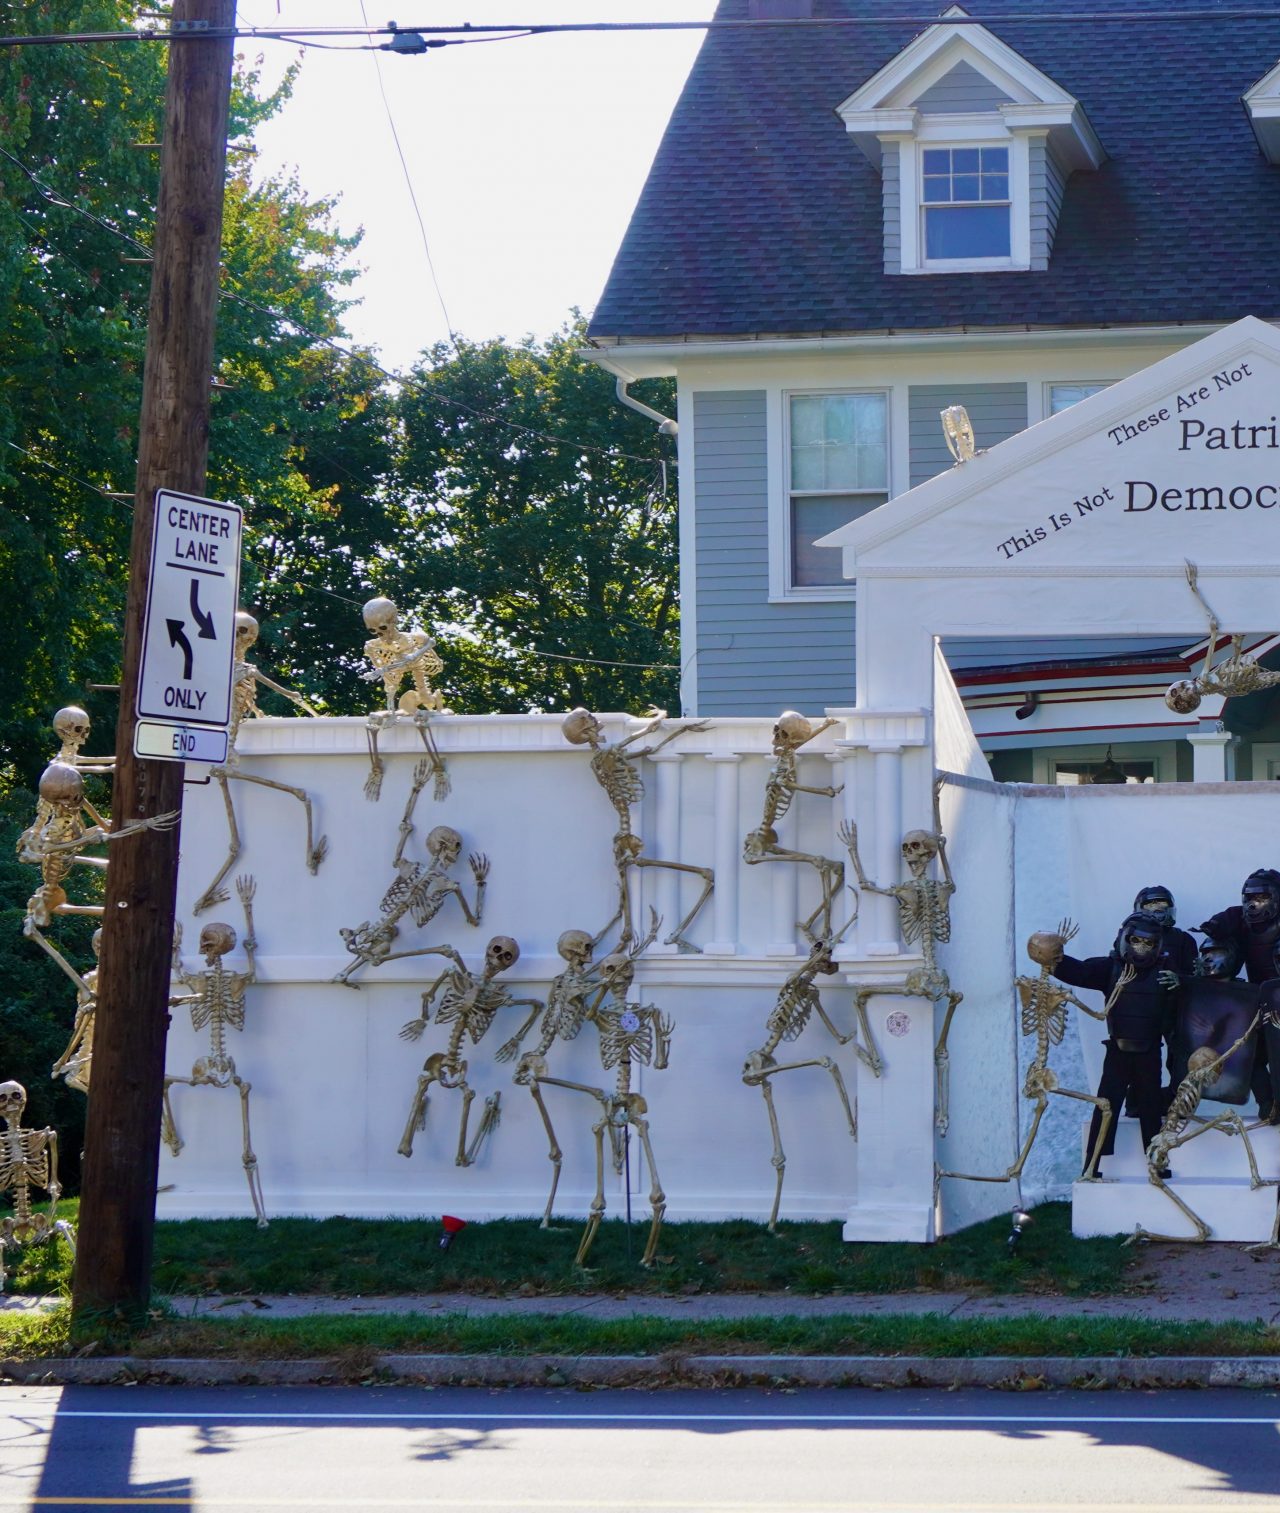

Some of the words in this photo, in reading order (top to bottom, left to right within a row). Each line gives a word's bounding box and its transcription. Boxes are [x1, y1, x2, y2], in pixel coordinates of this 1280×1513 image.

[1108, 409, 1170, 446] These
[1177, 388, 1210, 413] Are
[1212, 363, 1252, 392] Not
[168, 507, 230, 539] CENTER
[997, 526, 1047, 560] This
[1049, 513, 1072, 531] Is
[1074, 487, 1114, 516] Not
[175, 537, 219, 564] LANE
[164, 686, 207, 711] ONLY
[172, 733, 196, 752] END
